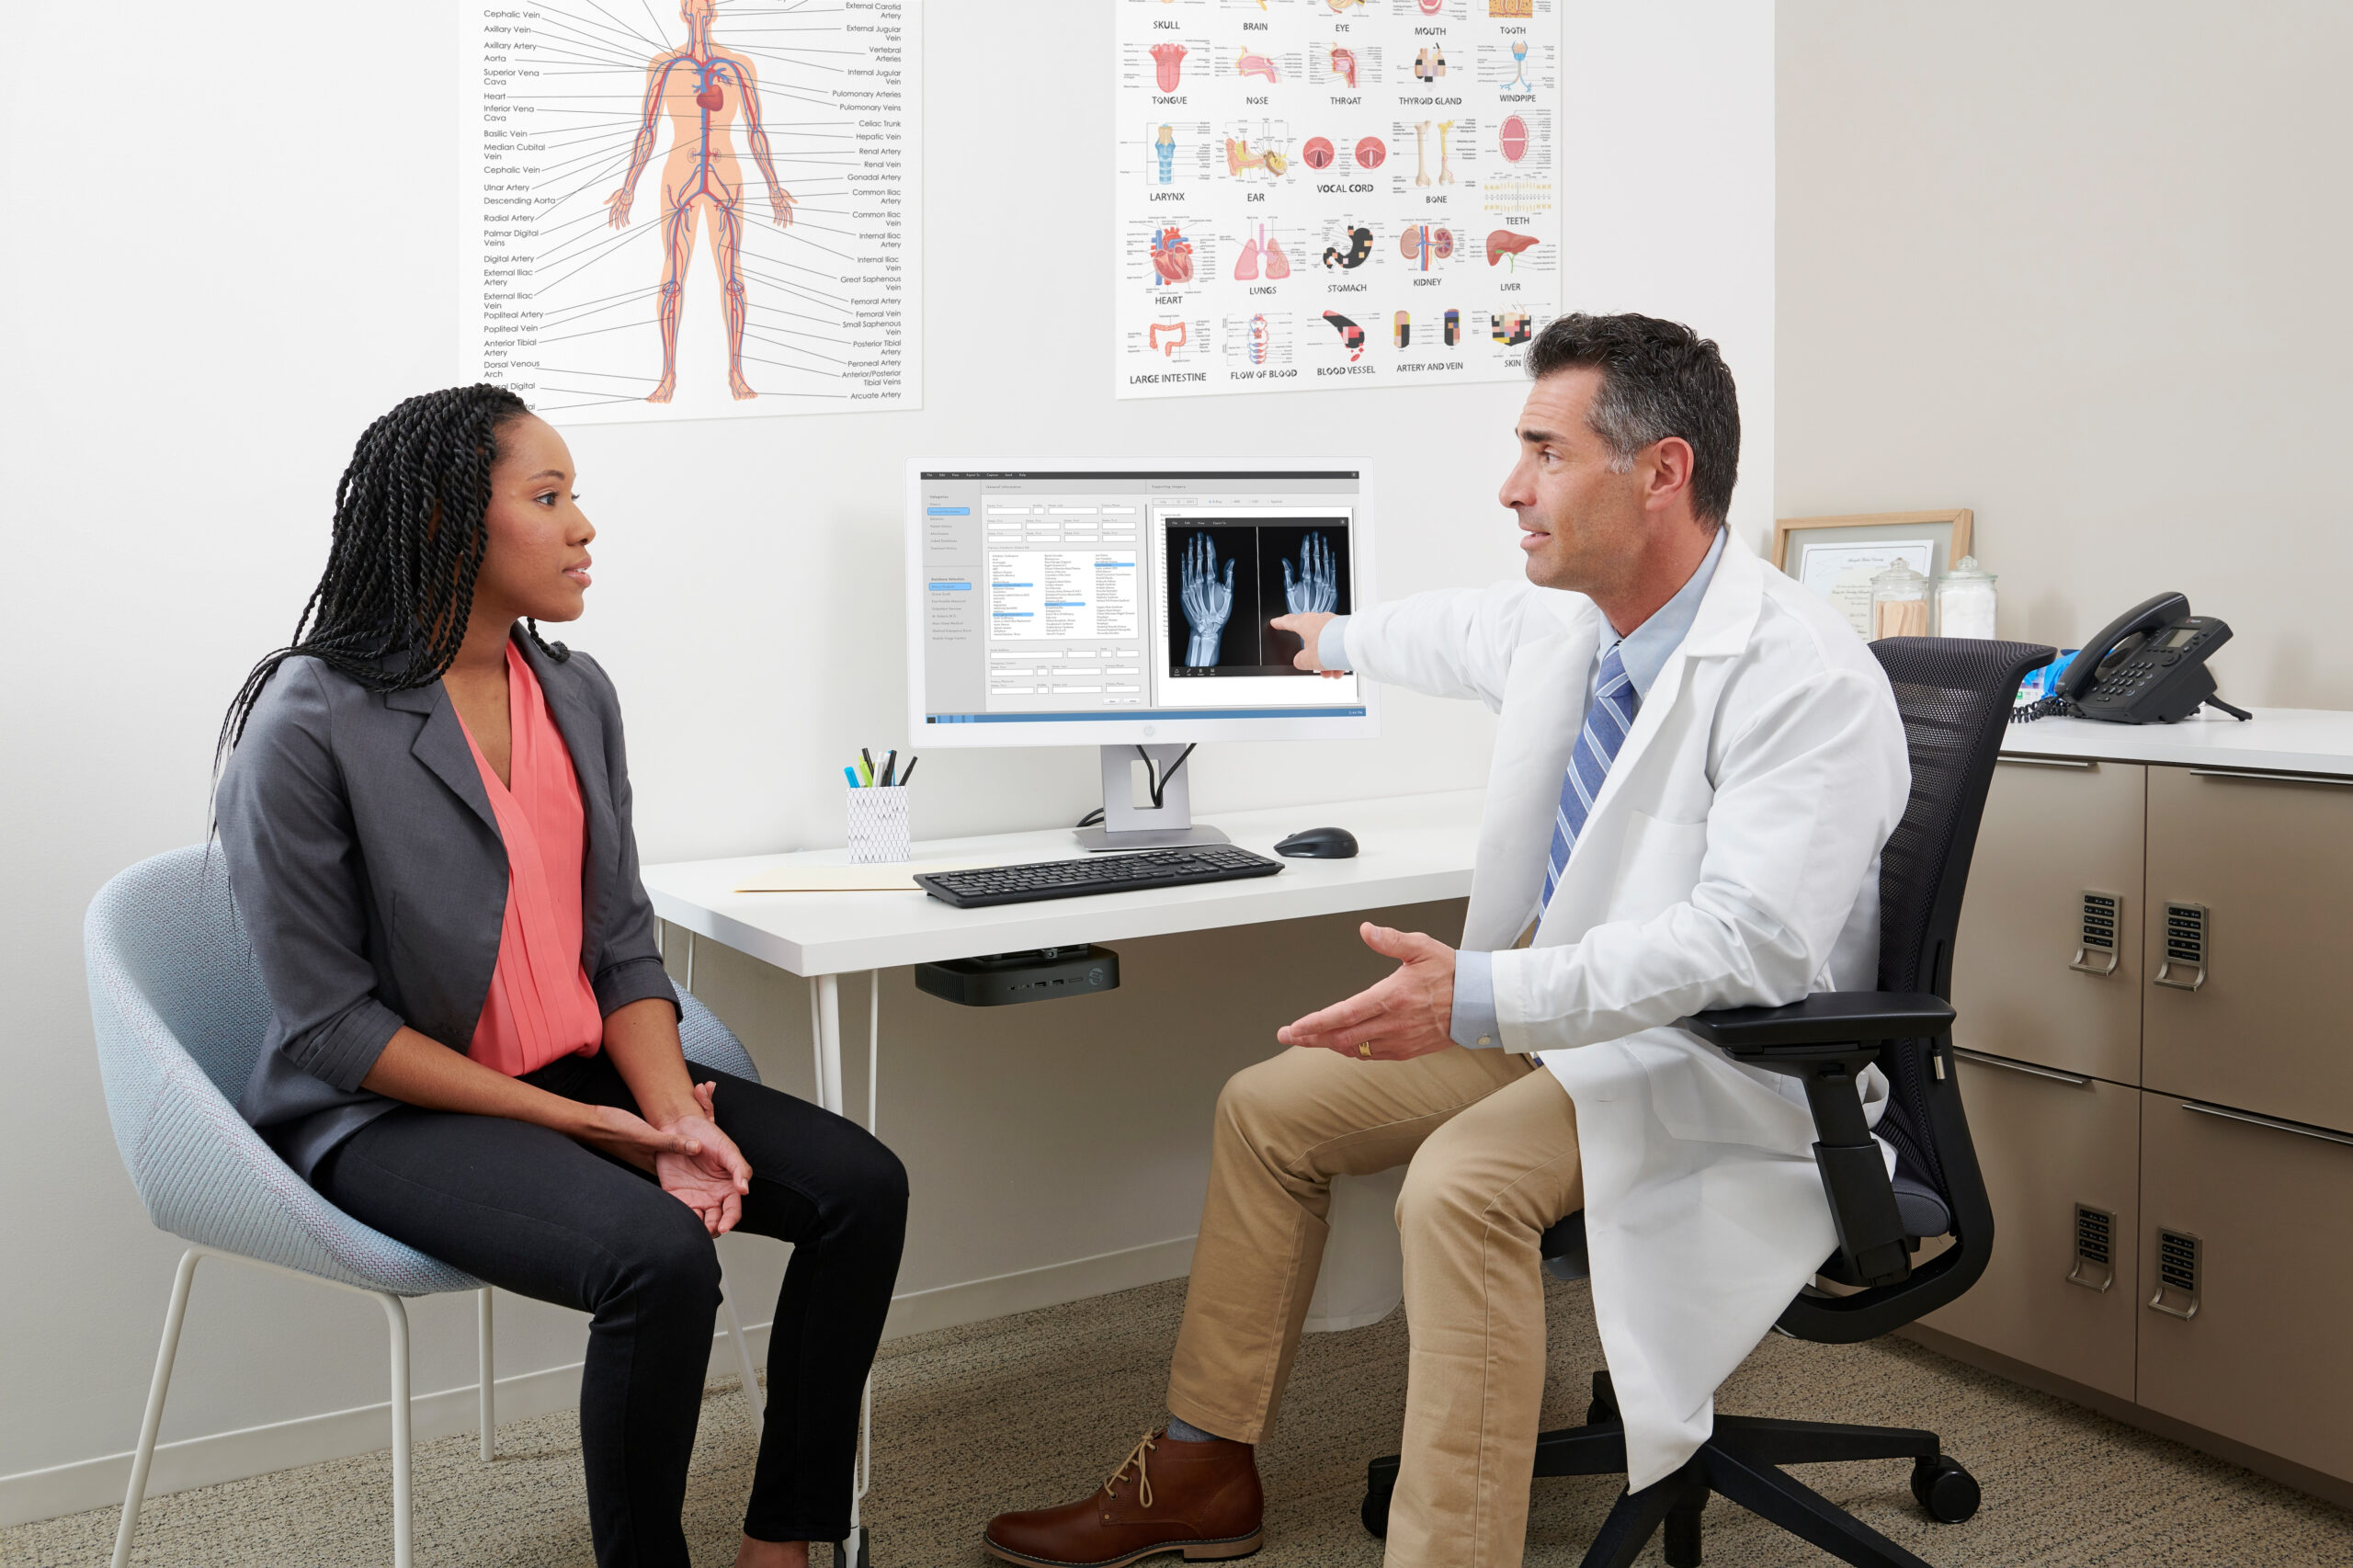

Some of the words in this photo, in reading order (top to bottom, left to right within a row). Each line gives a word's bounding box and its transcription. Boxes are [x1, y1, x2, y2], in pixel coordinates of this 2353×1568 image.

[484, 10, 520, 18] Cephalic
[1154, 21, 1180, 29] SKULL
[484, 26, 511, 34] Axillary
[484, 69, 516, 77] Superior
[833, 90, 874, 98] Pulomonary
[1246, 97, 1268, 105] NOSE
[484, 166, 520, 175] Cephalic
[1317, 185, 1347, 193] VOCAL
[1349, 184, 1374, 192] CORD
[1150, 193, 1185, 201] LARYNX
[1247, 193, 1265, 201] EAR
[514, 230, 539, 238] Digital
[484, 256, 508, 264] Digital
[863, 276, 901, 284] Saphenous
[1250, 287, 1277, 295] LUNGS
[1328, 284, 1367, 292] STOMACH
[1155, 296, 1183, 304] HEART
[484, 312, 518, 320] Popliteal
[484, 325, 518, 334] Popliteal
[484, 349, 507, 358] Artery
[1317, 367, 1346, 376] BLOOD
[1347, 366, 1375, 374] VESSEL
[1397, 364, 1426, 372] ARTERY
[842, 370, 901, 379] Anterior/Posterior
[1131, 375, 1159, 384] LARGE
[1162, 372, 1206, 382] INTESTINE
[1231, 371, 1254, 380] FLOW
[1269, 369, 1297, 378] BLOOD
[510, 382, 536, 391] Digital
